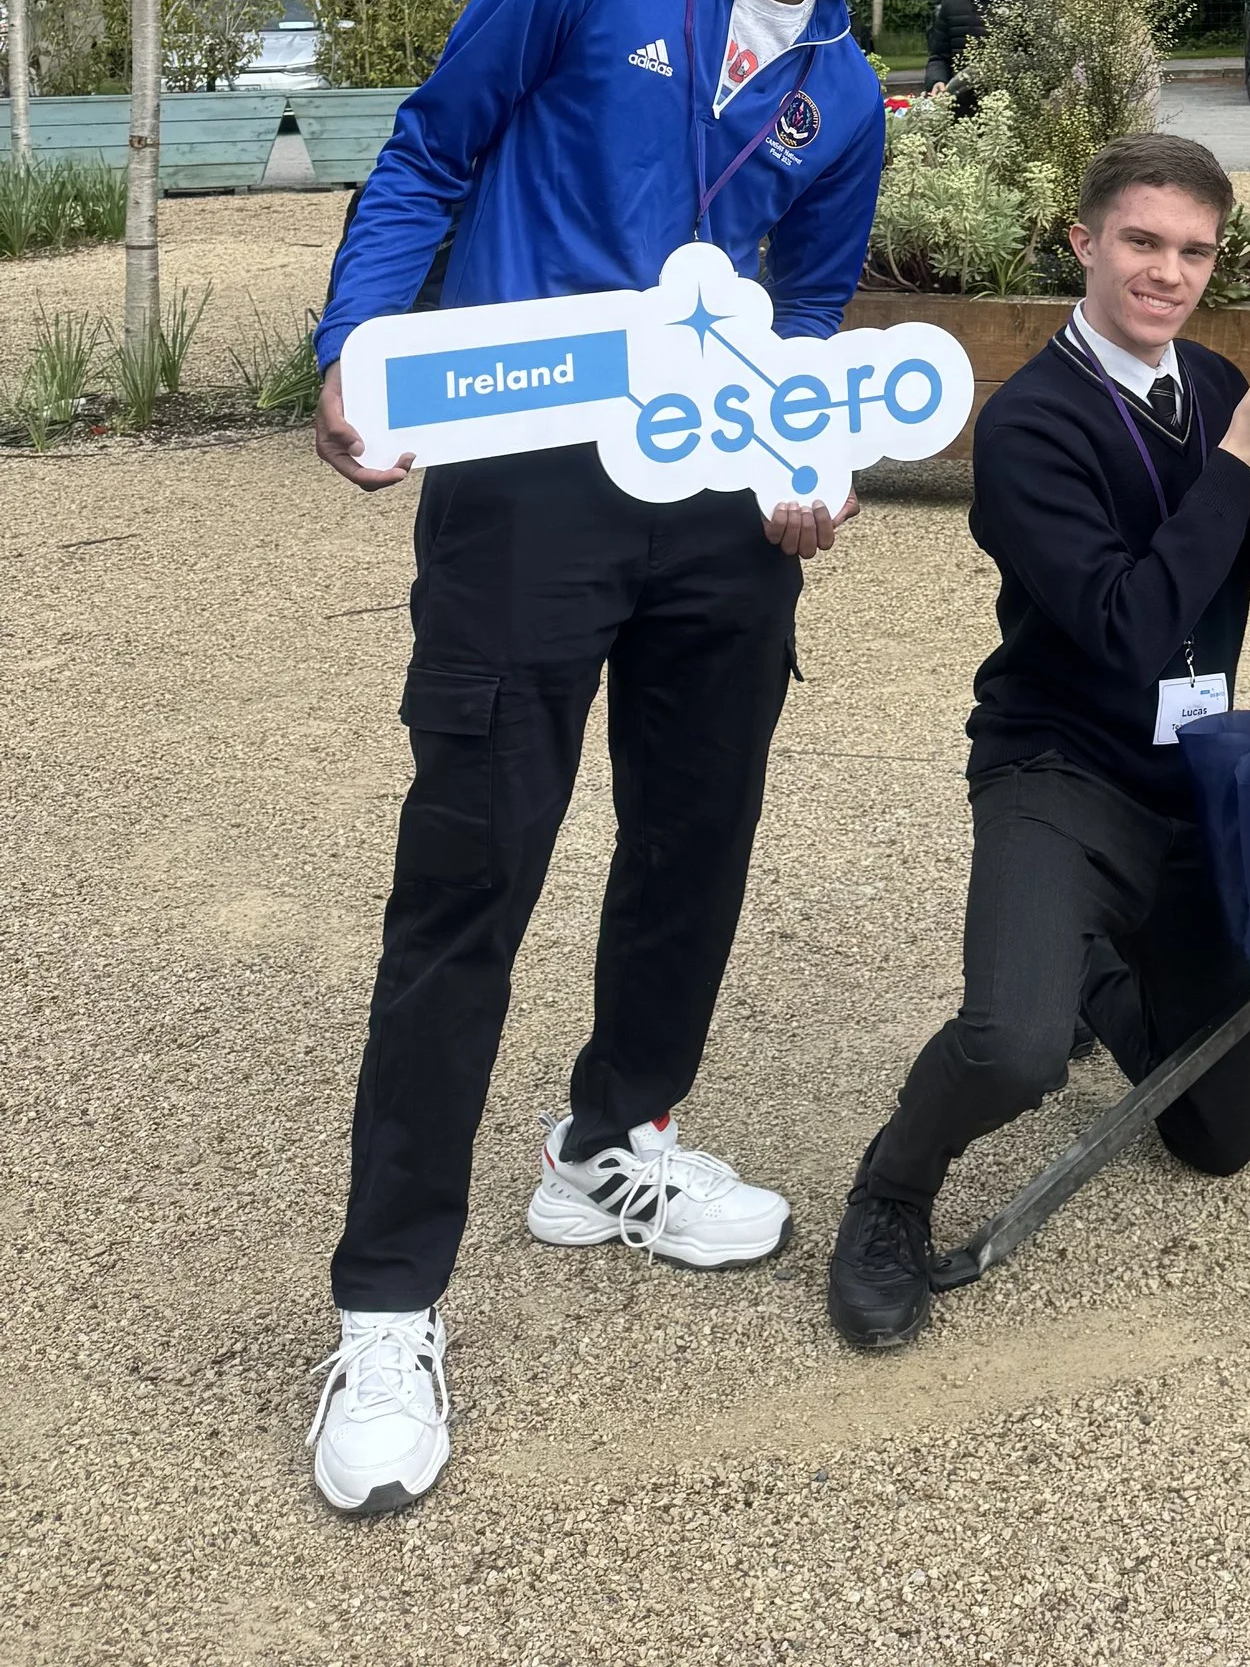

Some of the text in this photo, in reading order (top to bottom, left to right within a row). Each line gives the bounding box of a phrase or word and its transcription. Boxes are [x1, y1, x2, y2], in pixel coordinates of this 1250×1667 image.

[628, 52, 673, 77] adidas
[446, 353, 574, 399] Ireland
[636, 358, 942, 463] esero
[1182, 707, 1207, 717] Lucas
